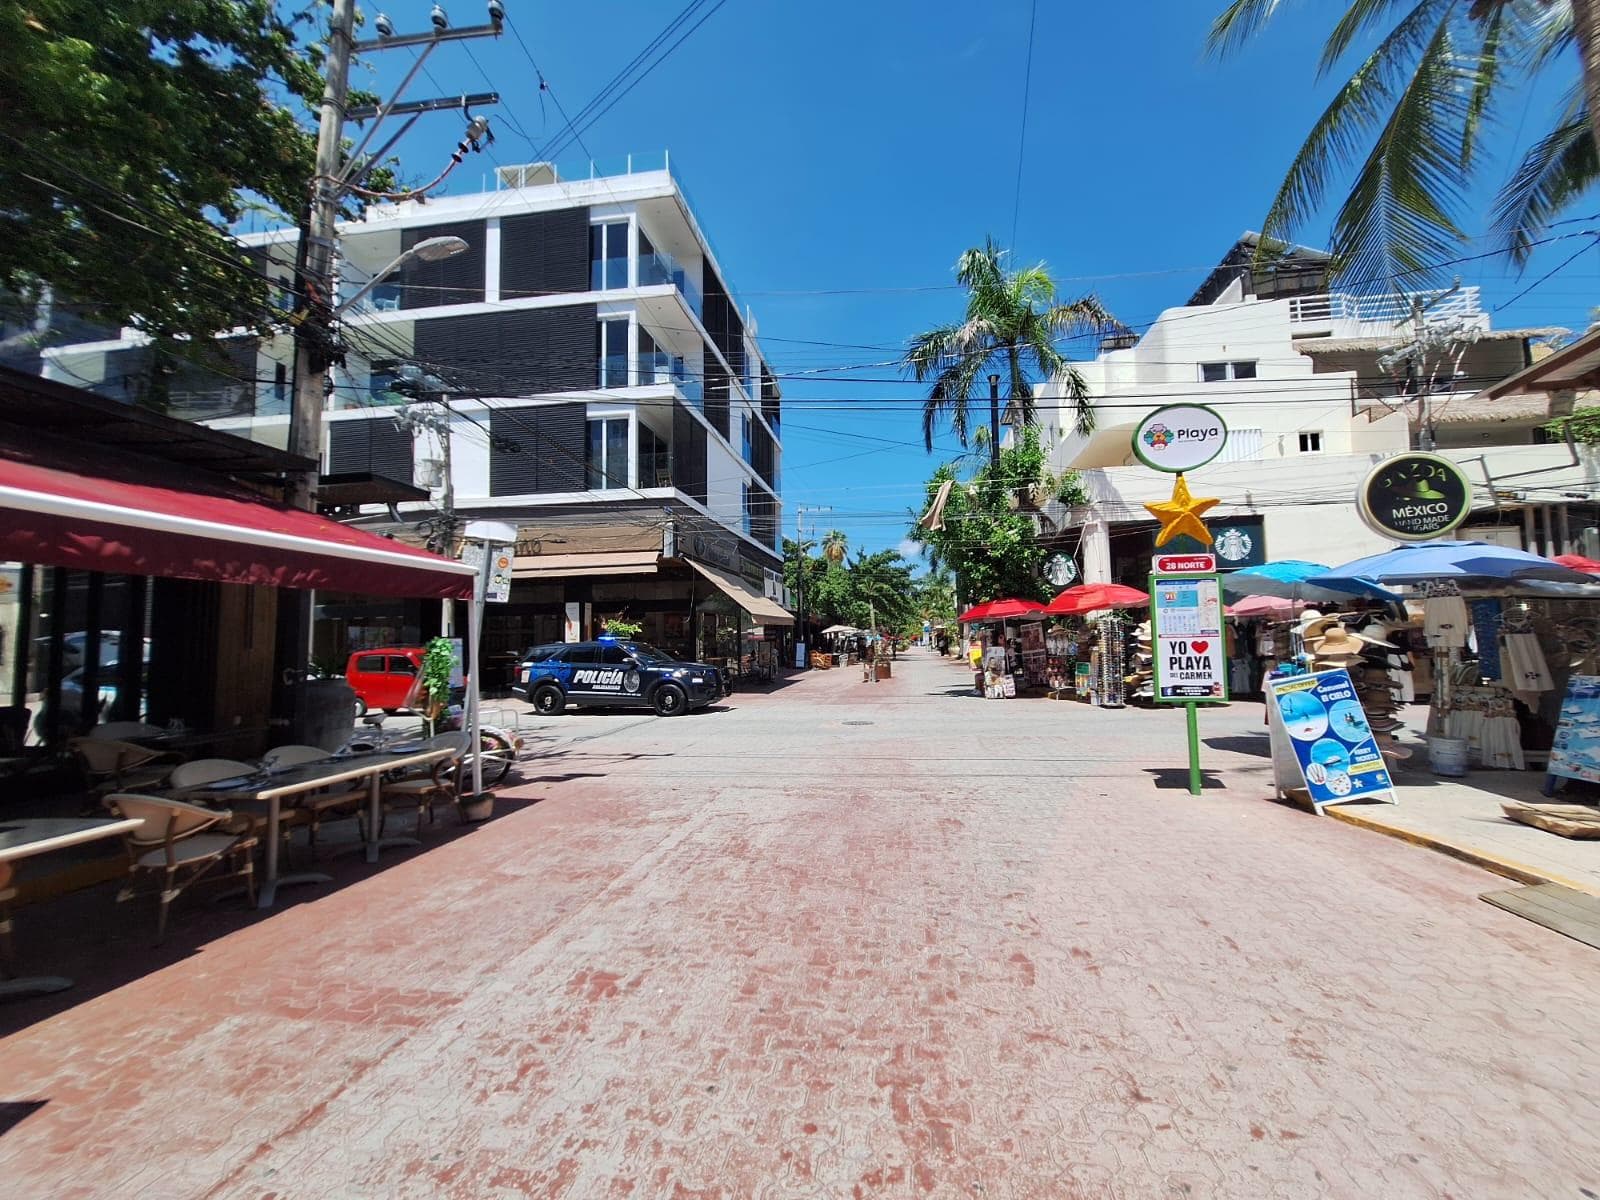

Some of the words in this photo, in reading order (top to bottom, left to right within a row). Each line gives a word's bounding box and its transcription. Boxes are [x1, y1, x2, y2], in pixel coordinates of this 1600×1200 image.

[1177, 427, 1218, 442] Playa
[1392, 502, 1448, 519] MÉXICO
[1422, 514, 1451, 525] MADE
[1165, 562, 1177, 570] 28
[1177, 561, 1206, 570] NORTE
[1169, 640, 1187, 655] YO
[1169, 655, 1212, 671] PLAYA
[573, 668, 624, 685] POLICÍA
[1179, 671, 1213, 680] CARMEN
